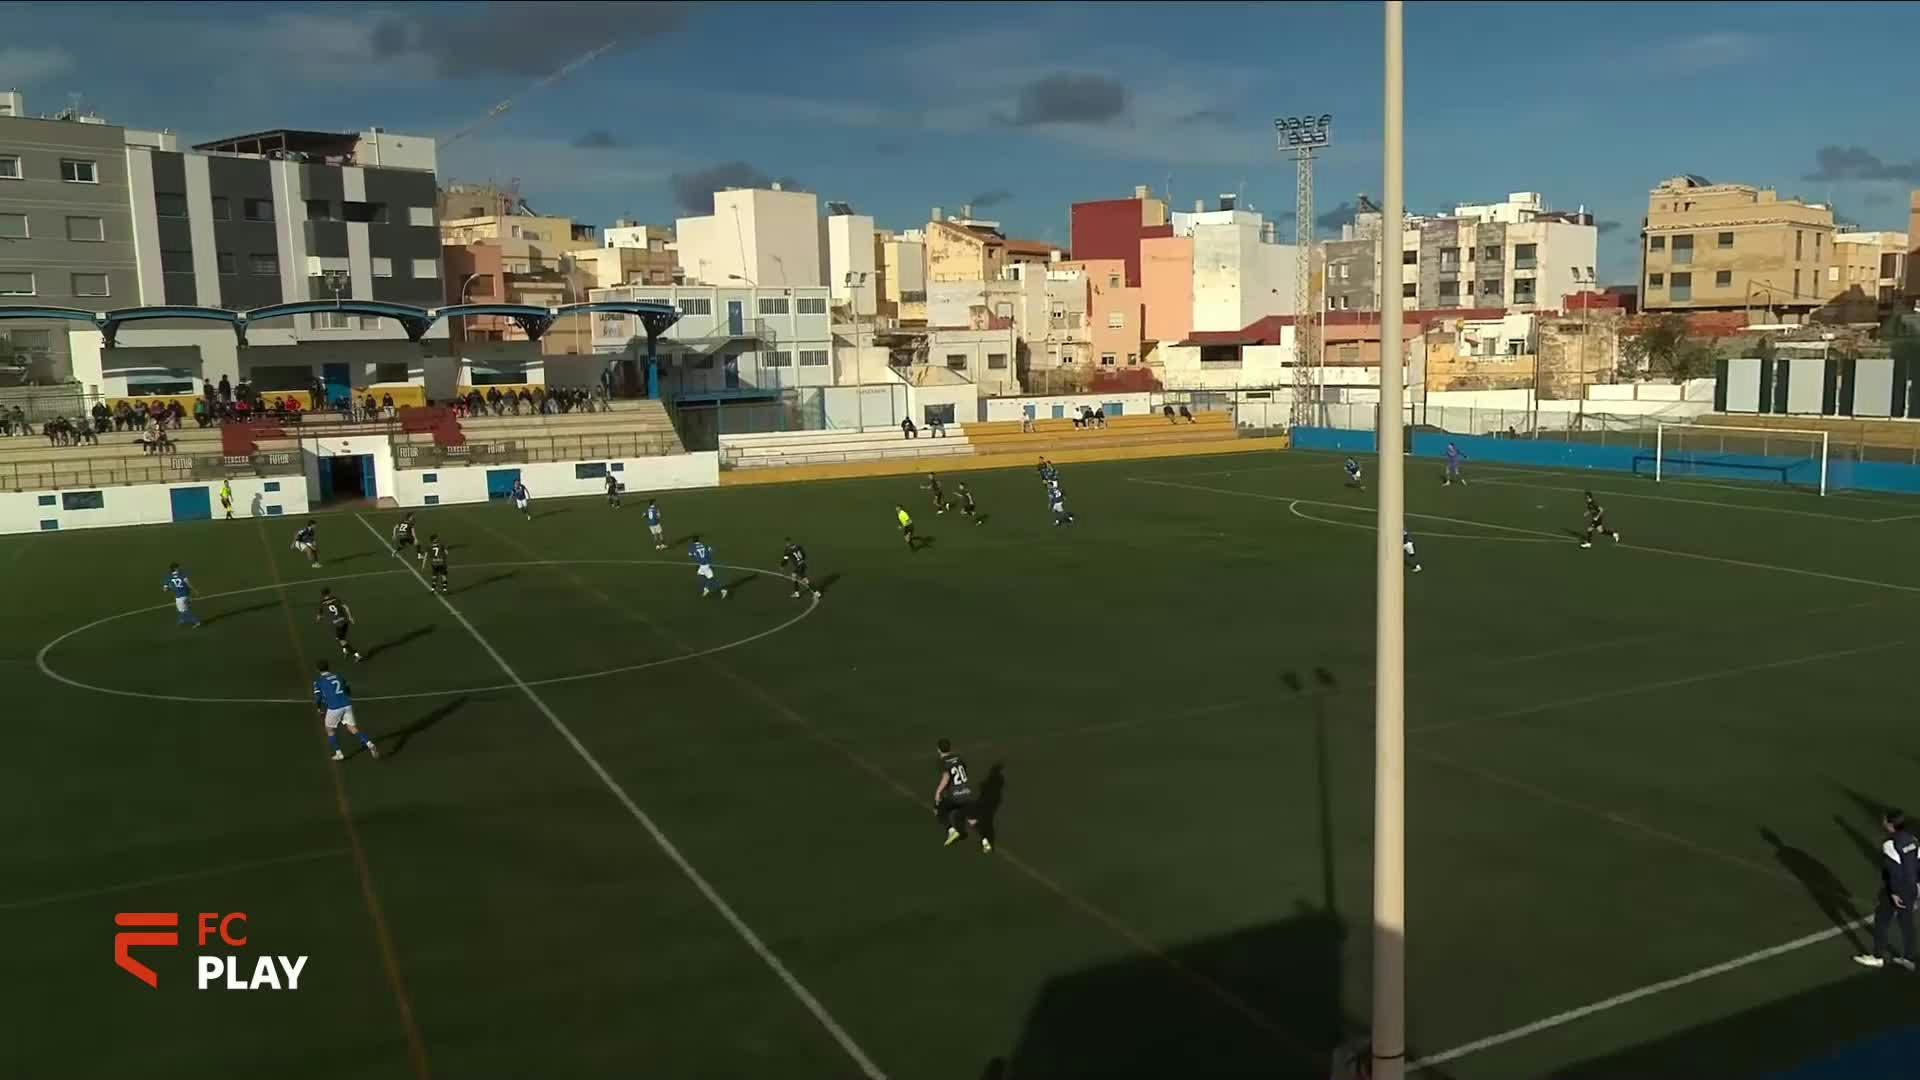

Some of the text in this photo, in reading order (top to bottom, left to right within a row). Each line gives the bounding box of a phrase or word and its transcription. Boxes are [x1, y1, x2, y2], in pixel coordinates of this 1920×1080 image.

[432, 547, 440, 557] 7
[171, 578, 184, 588] 12
[328, 604, 338, 616] 9
[331, 680, 344, 694] 2
[951, 765, 968, 785] 20
